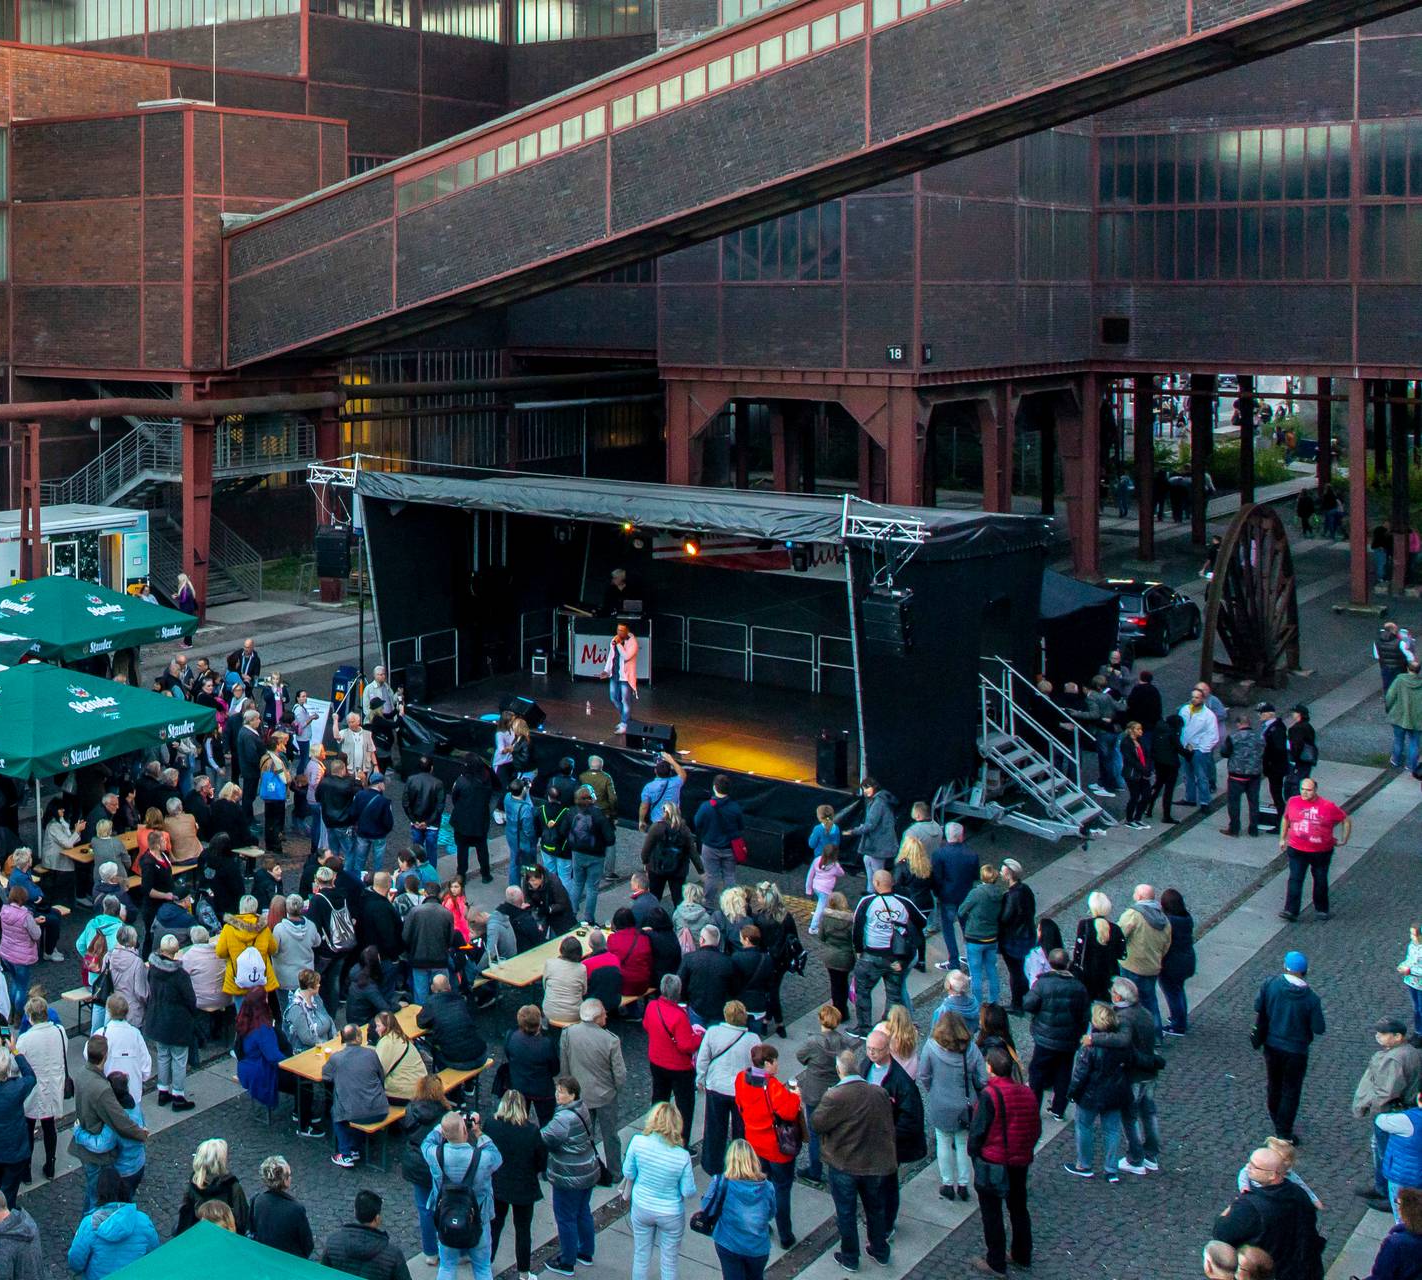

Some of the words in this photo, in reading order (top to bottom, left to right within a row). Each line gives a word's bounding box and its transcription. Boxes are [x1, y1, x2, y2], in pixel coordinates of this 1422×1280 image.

[889, 348, 902, 359] 18
[87, 603, 124, 617] Stauder
[161, 626, 182, 638] Stauder
[90, 639, 112, 653] Stauder
[581, 643, 607, 664] Mü
[69, 696, 118, 714] Stauder
[167, 721, 195, 738] Stauder
[70, 745, 101, 764] Stauder
